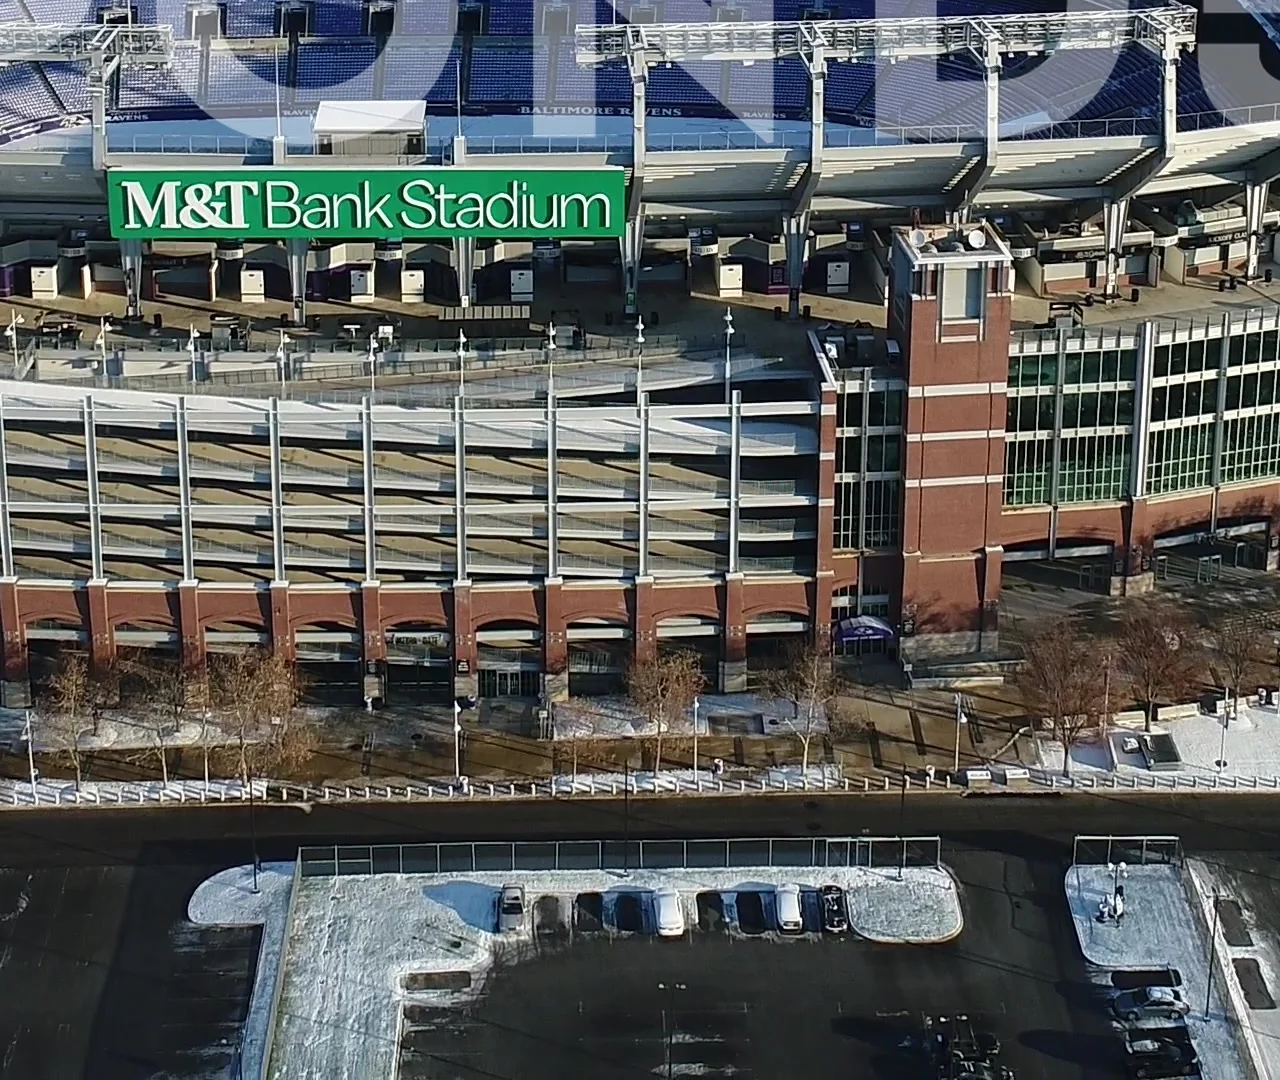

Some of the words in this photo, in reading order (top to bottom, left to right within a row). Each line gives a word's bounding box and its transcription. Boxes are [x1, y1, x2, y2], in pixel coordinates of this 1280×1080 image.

[521, 106, 614, 115] BALTIMORE
[742, 110, 786, 119] RAVENS
[121, 180, 258, 228] M&T
[266, 180, 394, 228] Bank
[401, 180, 611, 228] Stadium
